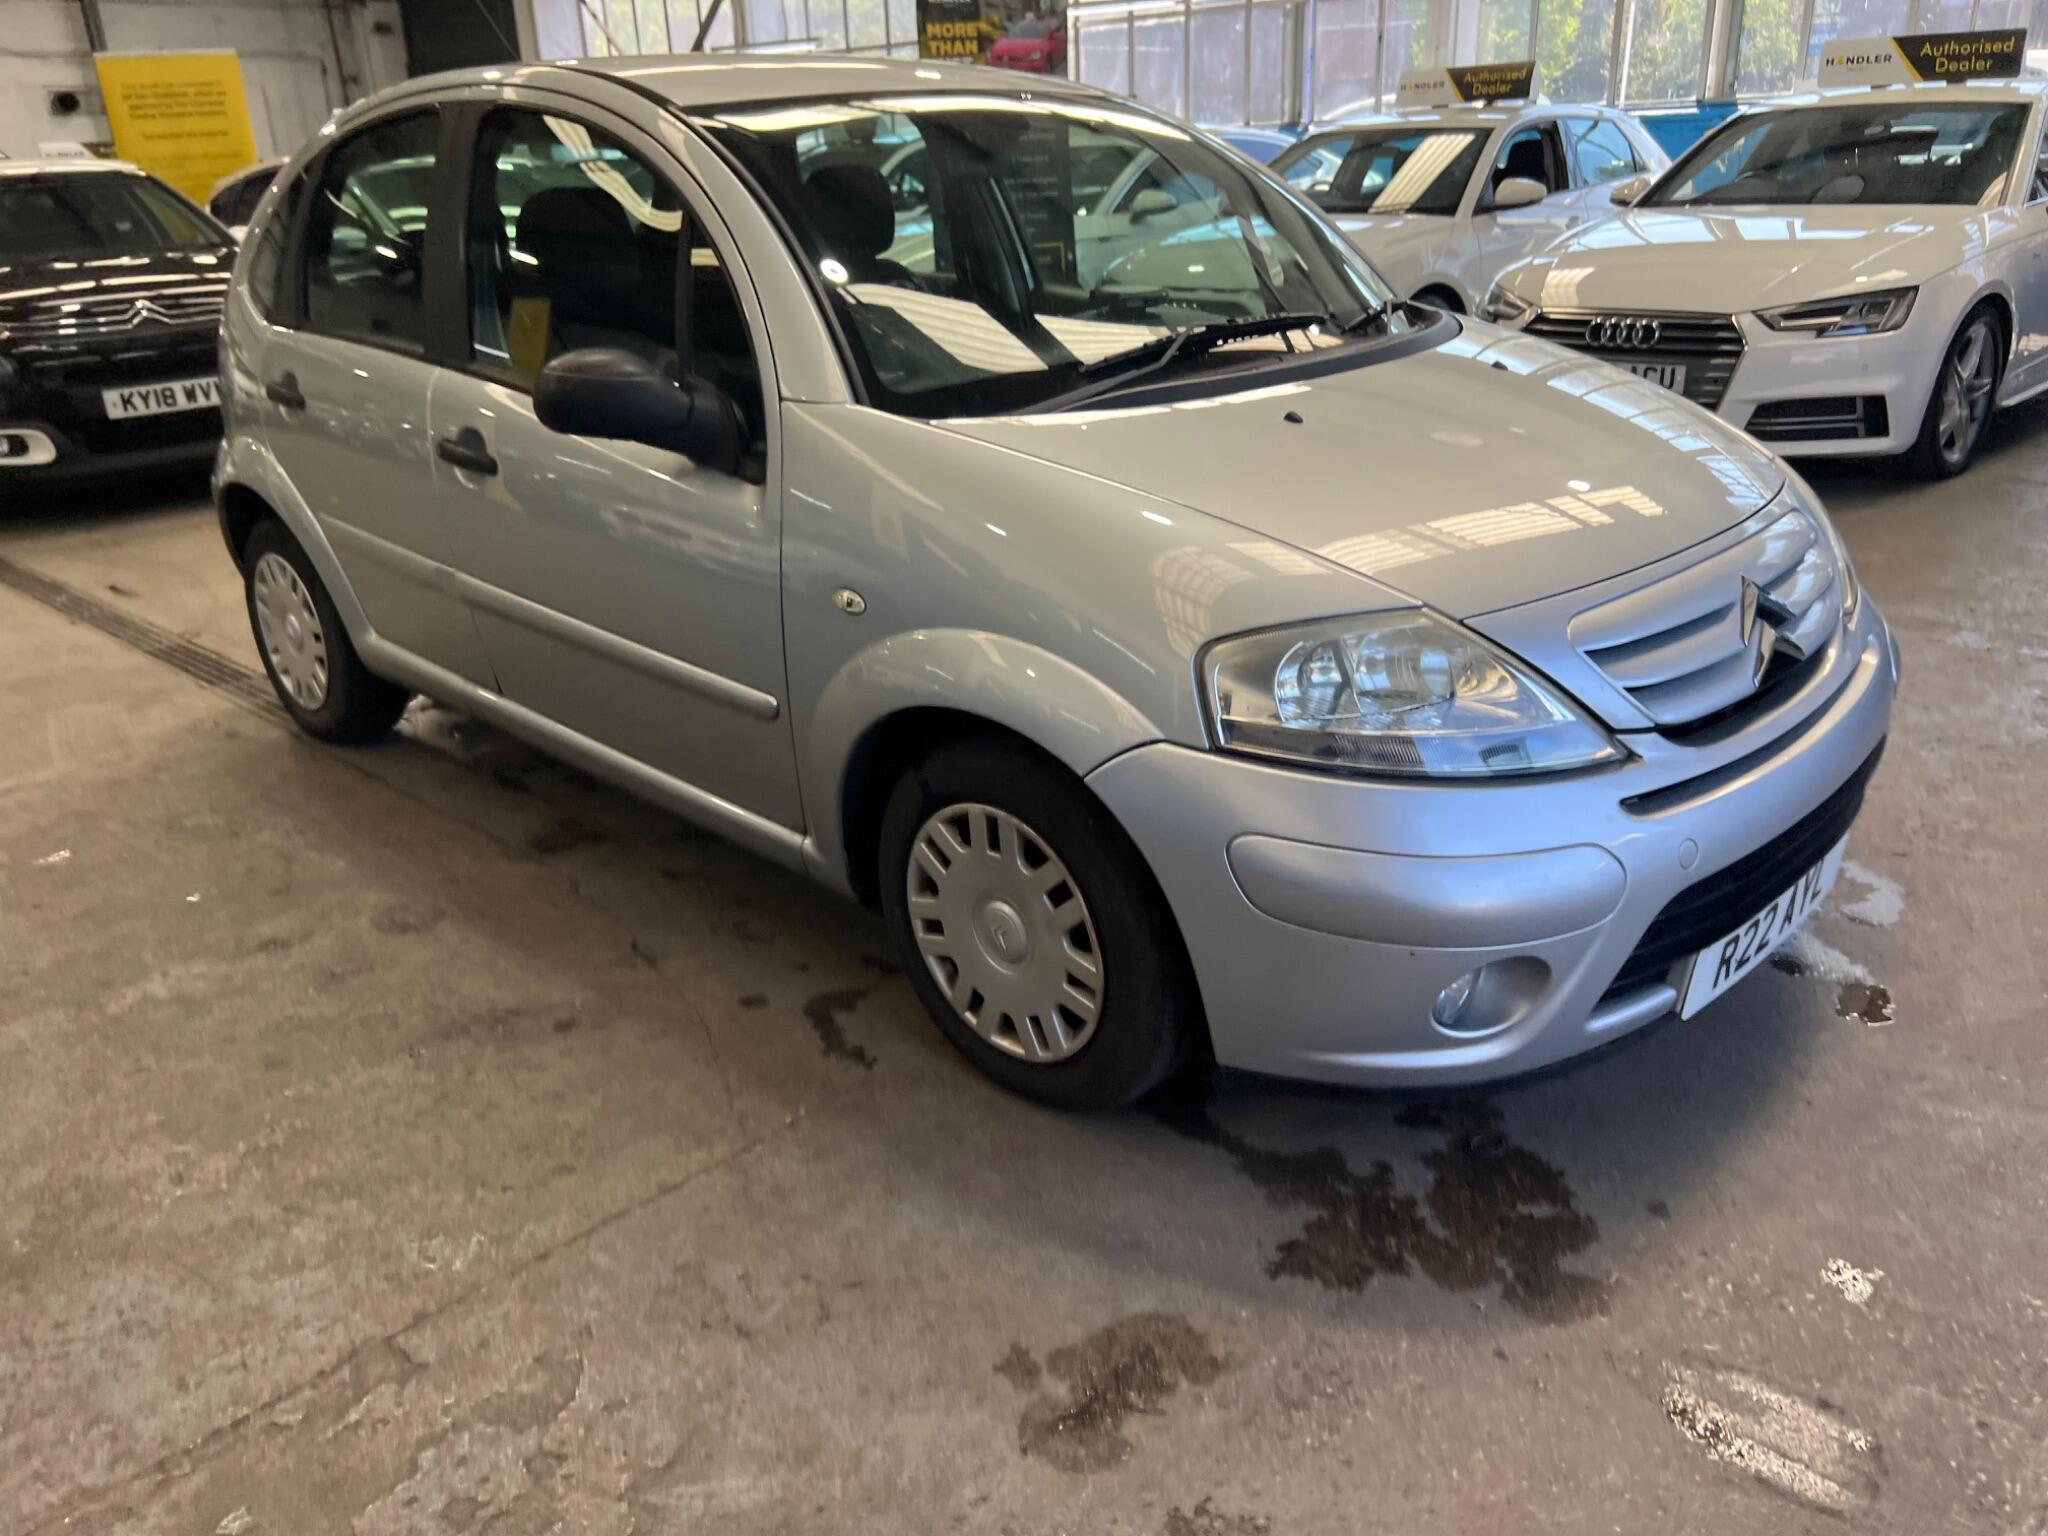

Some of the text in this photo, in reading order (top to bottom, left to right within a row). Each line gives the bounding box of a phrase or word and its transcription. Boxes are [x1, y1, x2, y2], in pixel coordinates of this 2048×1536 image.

[926, 22, 978, 38] MORE
[928, 39, 978, 56] THAN
[1919, 36, 2016, 58] Authorised
[1825, 53, 1893, 68] HANDLER
[1934, 56, 1994, 74] Dealer
[1463, 67, 1528, 83] Authorised
[1472, 82, 1513, 97] Dealer
[119, 386, 178, 413] KY18
[1712, 901, 1780, 991] R22
